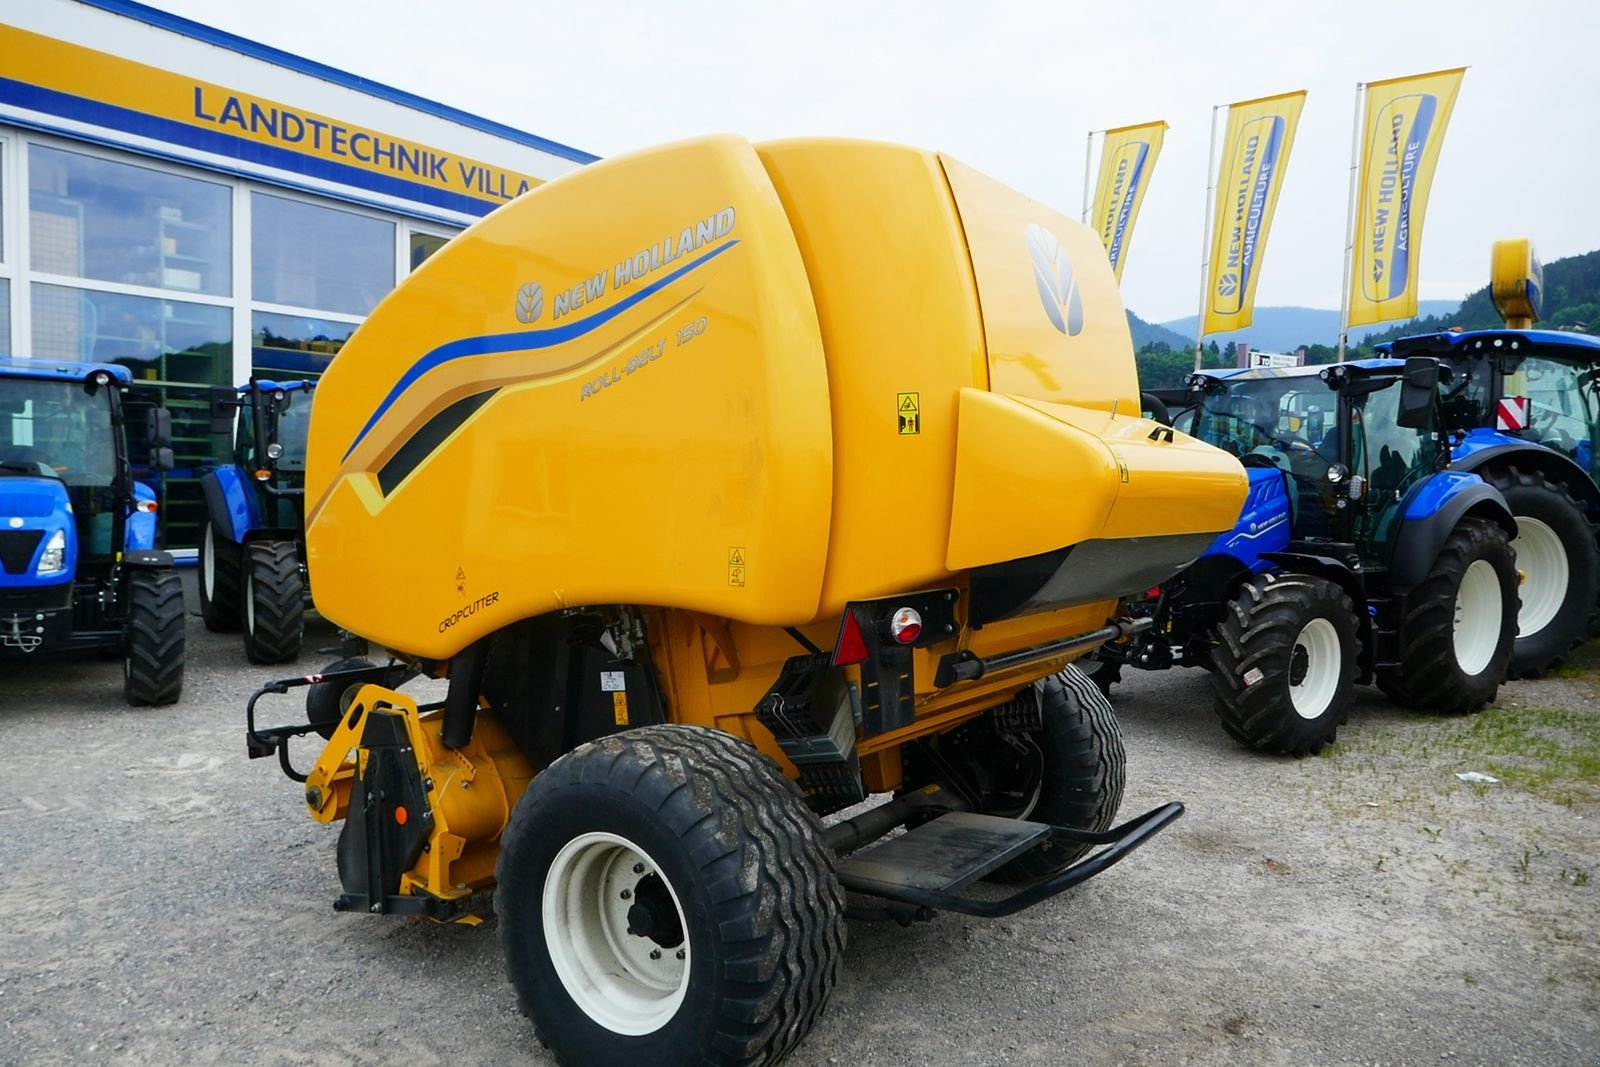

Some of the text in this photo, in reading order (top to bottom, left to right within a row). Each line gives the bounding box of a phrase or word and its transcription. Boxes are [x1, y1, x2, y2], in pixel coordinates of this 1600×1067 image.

[193, 86, 448, 184] LANDTECHNIK
[1374, 113, 1404, 253] NEW HOLLAND
[1104, 158, 1128, 239] HOLLAND
[1227, 135, 1260, 268] NEW HOLLAND
[1243, 162, 1271, 266] AGRICULTURE
[1397, 141, 1420, 251] AGRICULTURE
[553, 206, 736, 320] NEW HOLLAND
[580, 316, 708, 402] ROLL-BELT 150
[438, 591, 499, 633] CROPCUTTER
